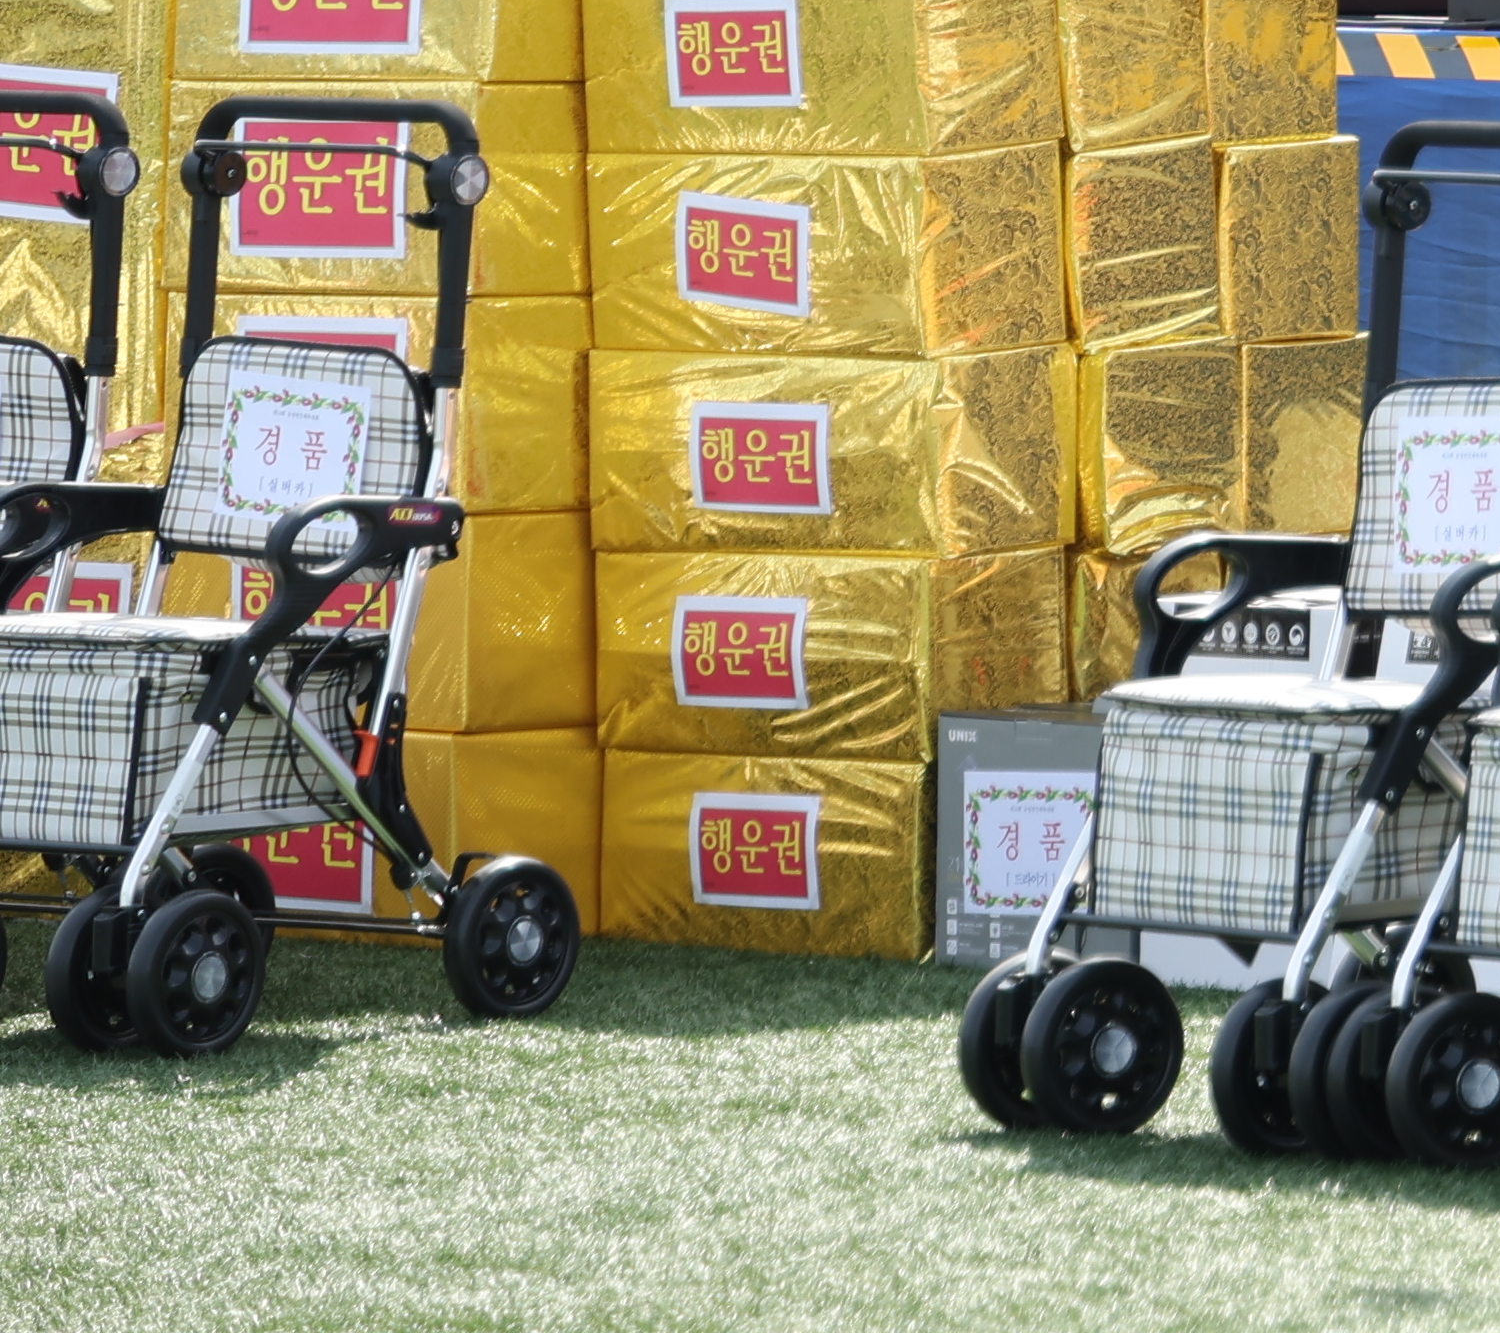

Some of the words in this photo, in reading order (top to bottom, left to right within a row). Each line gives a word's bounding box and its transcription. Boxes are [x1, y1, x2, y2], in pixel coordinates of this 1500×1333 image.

[677, 21, 785, 76] 행운권
[244, 135, 389, 216] 행운권
[687, 219, 794, 283] 행운권
[701, 427, 812, 484] 행운권
[684, 620, 789, 677] 행운권
[701, 818, 802, 875] 행운권
